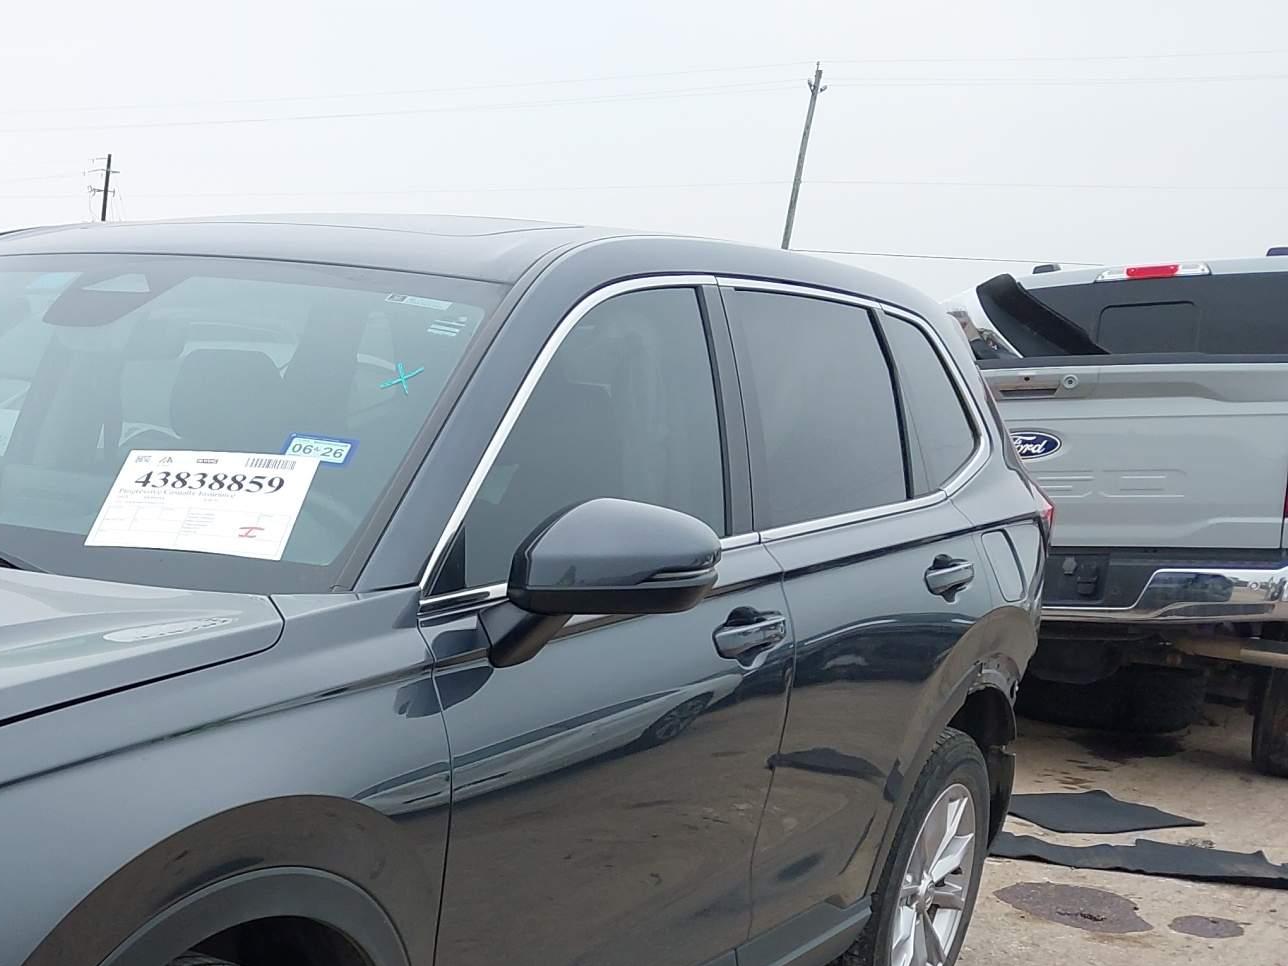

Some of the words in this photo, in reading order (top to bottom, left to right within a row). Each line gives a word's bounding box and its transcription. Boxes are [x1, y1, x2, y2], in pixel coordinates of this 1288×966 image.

[292, 443, 314, 455] 06
[320, 446, 345, 459] 26
[134, 470, 285, 495] 43838859
